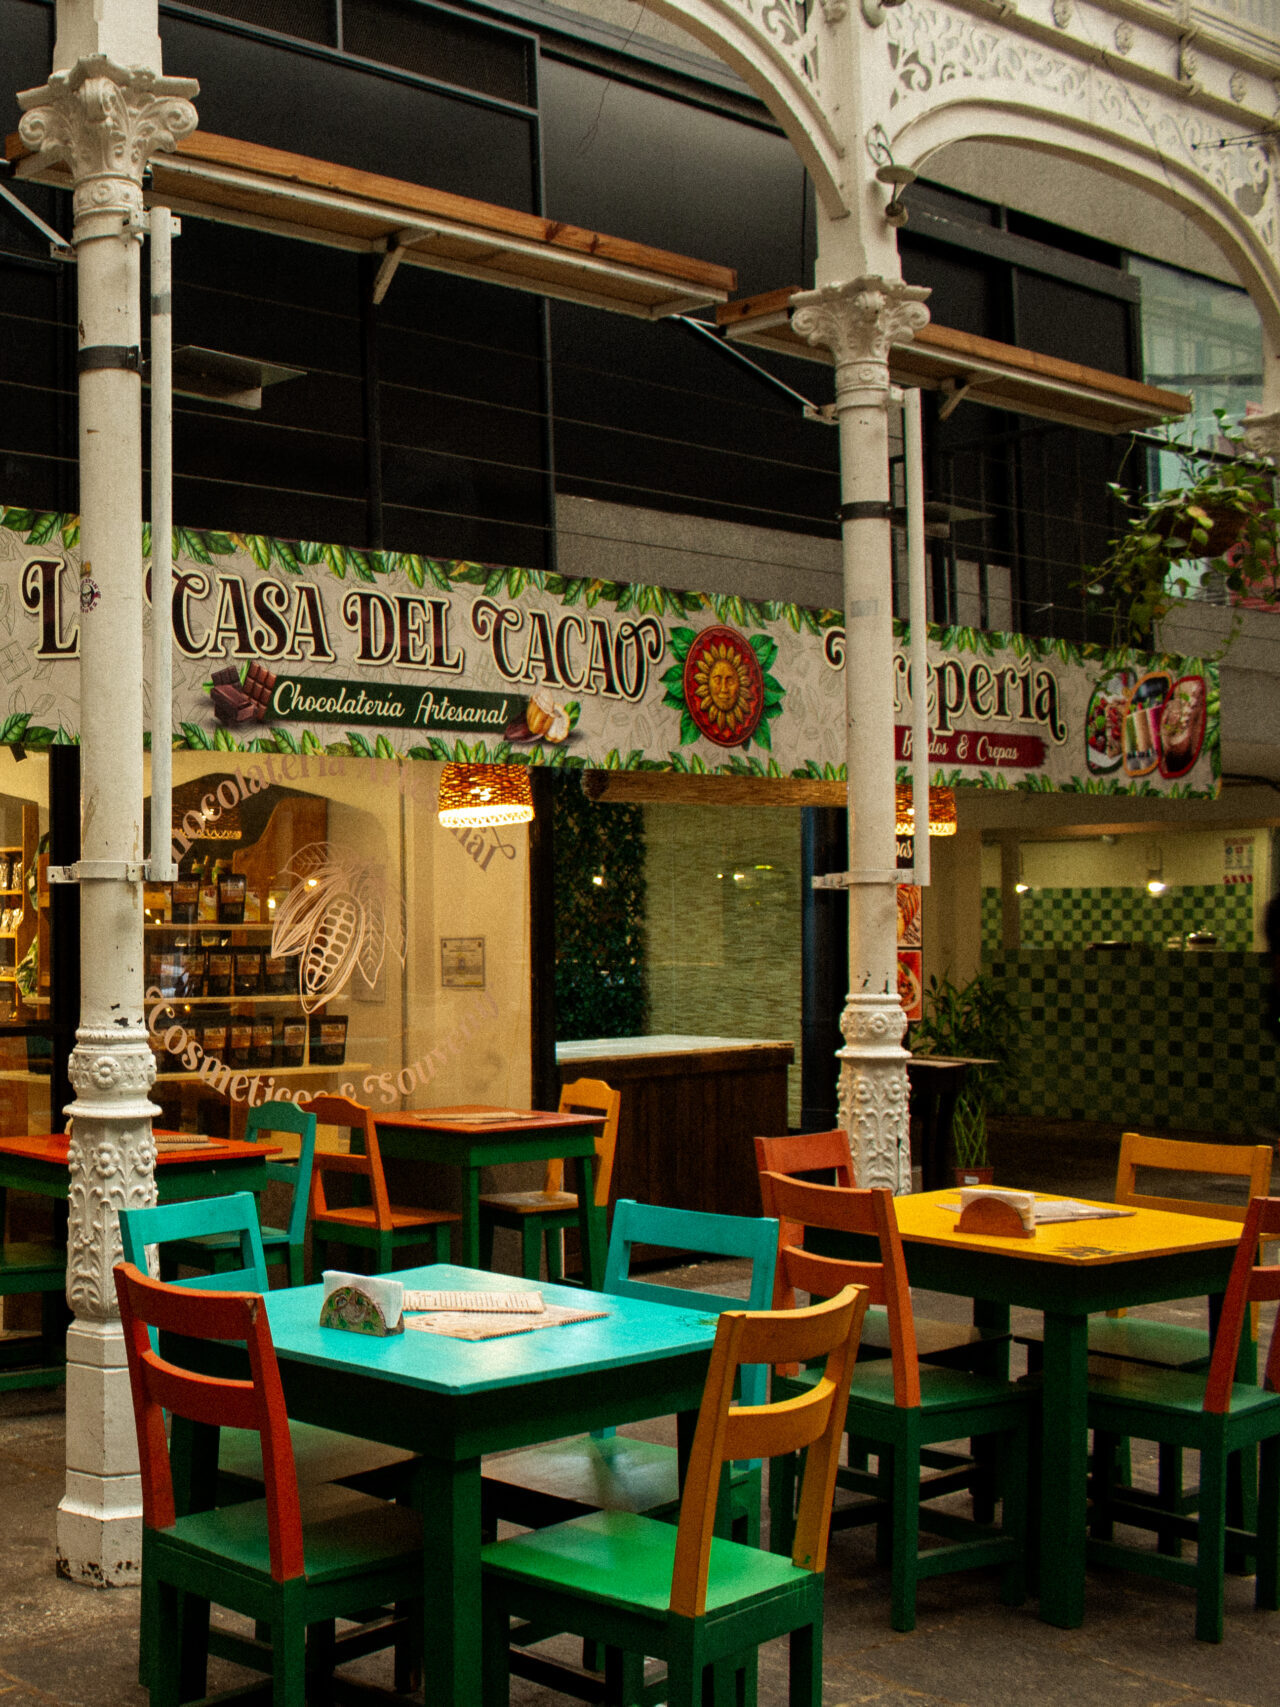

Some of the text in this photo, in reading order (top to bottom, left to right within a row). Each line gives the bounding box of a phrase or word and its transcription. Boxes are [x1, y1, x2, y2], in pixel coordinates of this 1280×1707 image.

[21, 557, 665, 703] L CASA DEL CACAO
[273, 680, 509, 725] Chocolatería Artesanal
[956, 733, 971, 760] &
[976, 736, 1020, 766] Crepas
